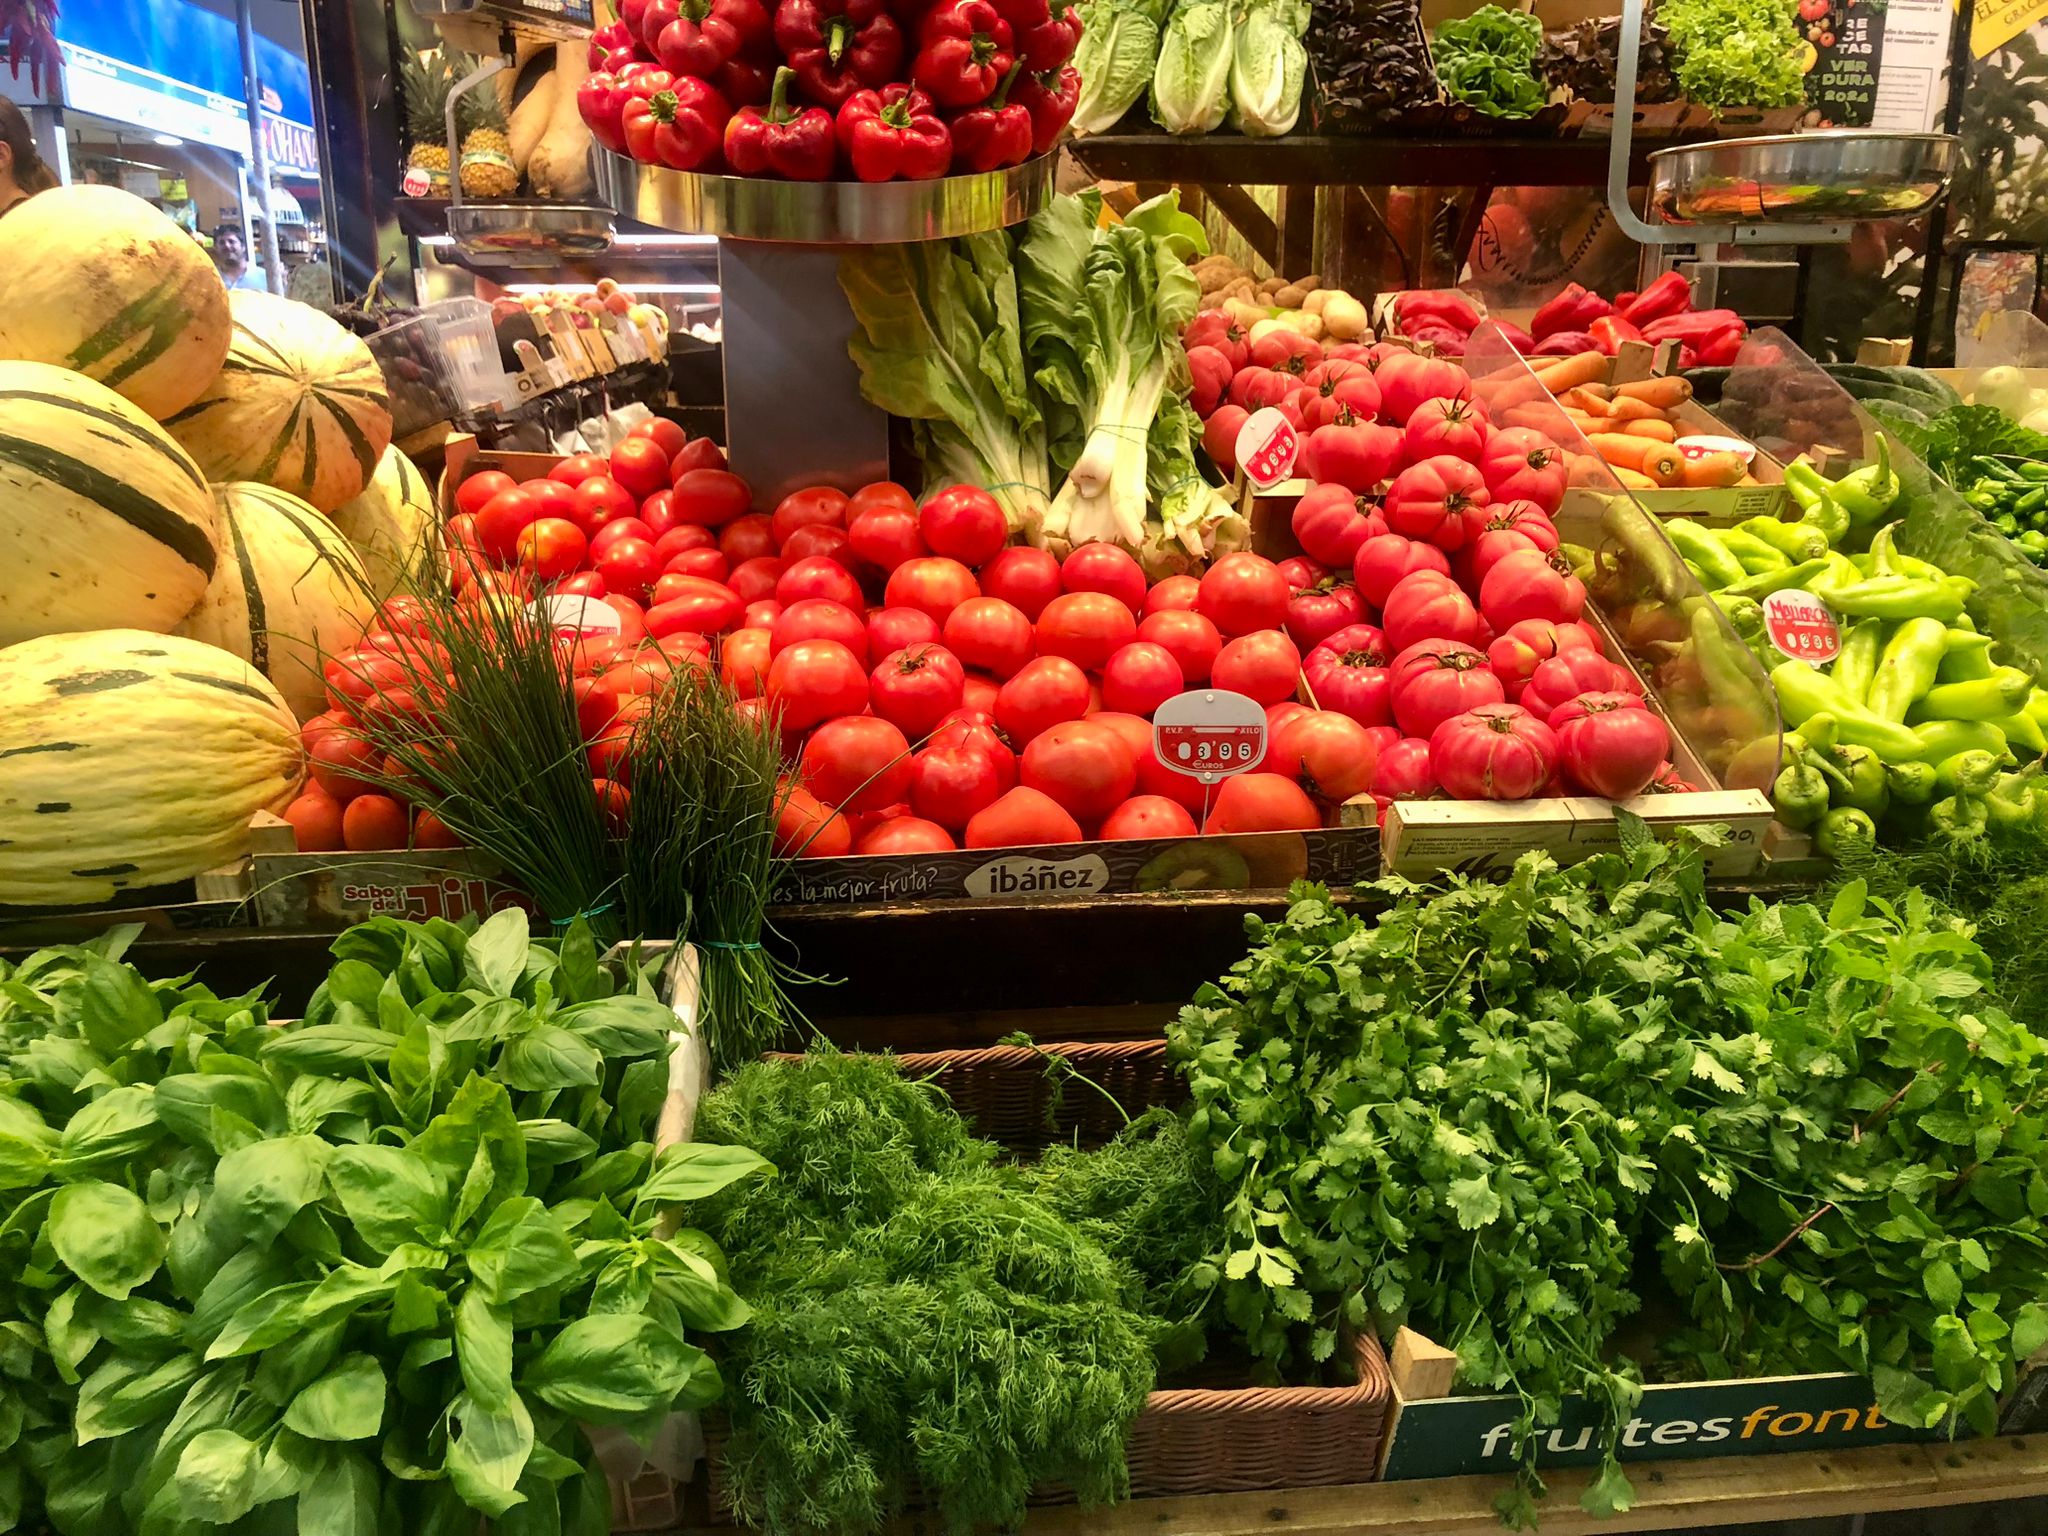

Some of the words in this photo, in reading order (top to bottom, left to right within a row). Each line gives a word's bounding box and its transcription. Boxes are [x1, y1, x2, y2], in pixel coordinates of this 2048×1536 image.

[1976, 2, 1993, 20] EL
[1836, 43, 1873, 55] TAS
[1830, 59, 1868, 72] VER
[1822, 73, 1875, 86] DURA
[1824, 90, 1870, 103] 2024
[823, 879, 875, 902] mejor
[879, 864, 938, 902] fruta?
[990, 865, 1094, 893] ibáñez
